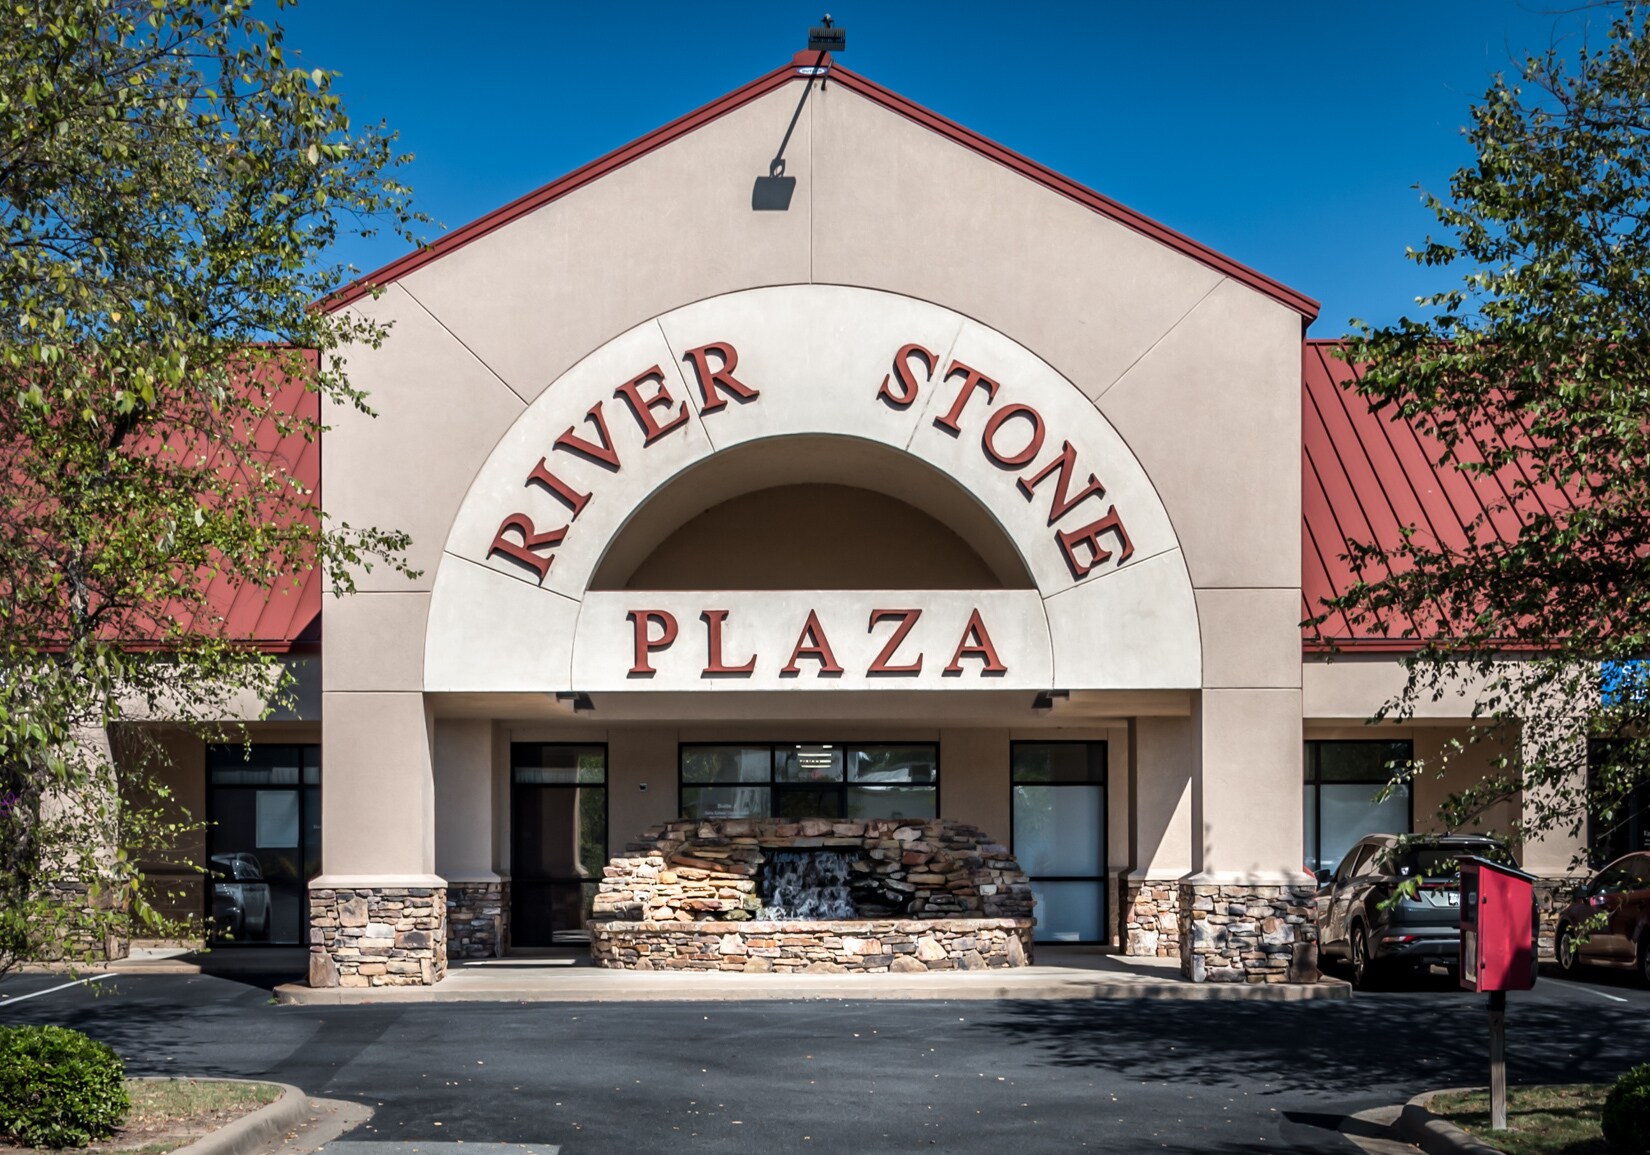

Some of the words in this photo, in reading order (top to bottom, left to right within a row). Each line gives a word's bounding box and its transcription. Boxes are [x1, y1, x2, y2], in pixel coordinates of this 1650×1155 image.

[487, 341, 760, 586] RIVER
[877, 343, 1136, 579] STONE
[626, 607, 1008, 679] PLAZA
